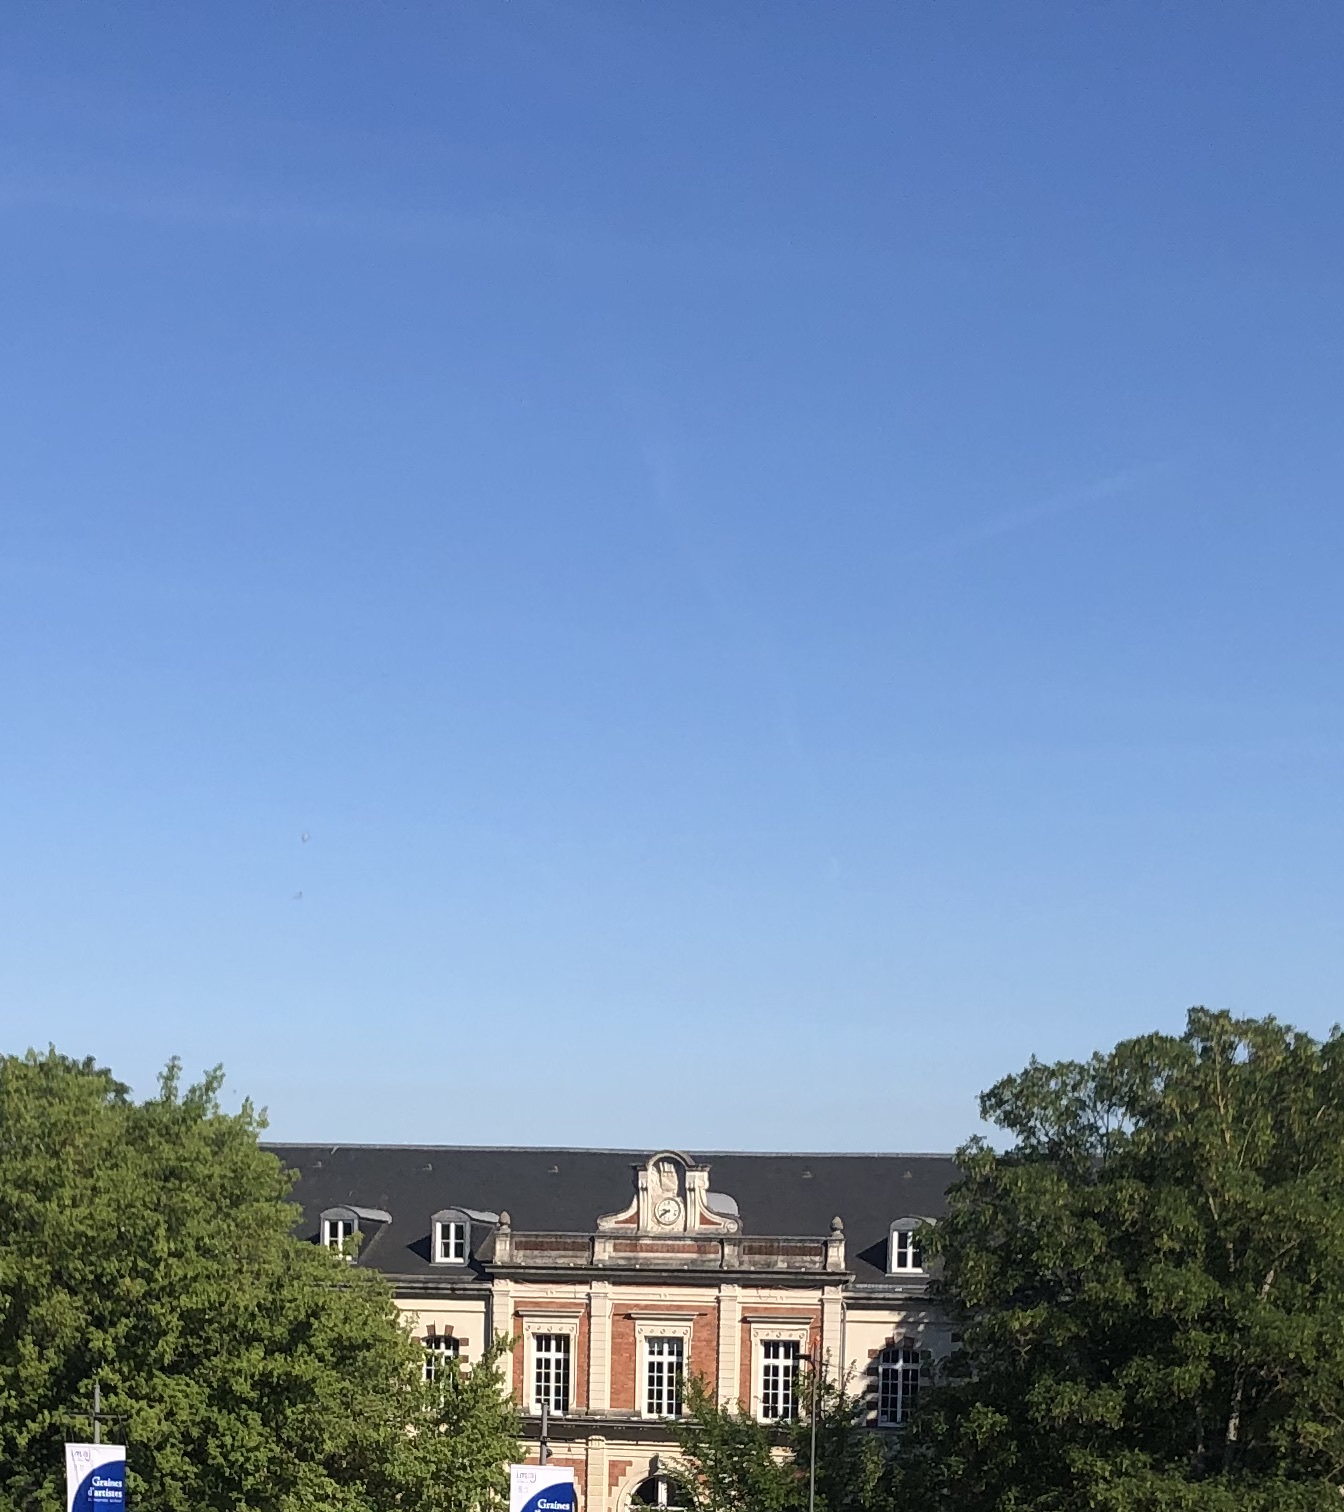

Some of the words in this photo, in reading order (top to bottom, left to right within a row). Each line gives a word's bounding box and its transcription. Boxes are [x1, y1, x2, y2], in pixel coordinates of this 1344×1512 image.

[91, 1476, 123, 1488] Graines
[87, 1487, 123, 1498] d'artistes
[537, 1499, 570, 1510] Graines
